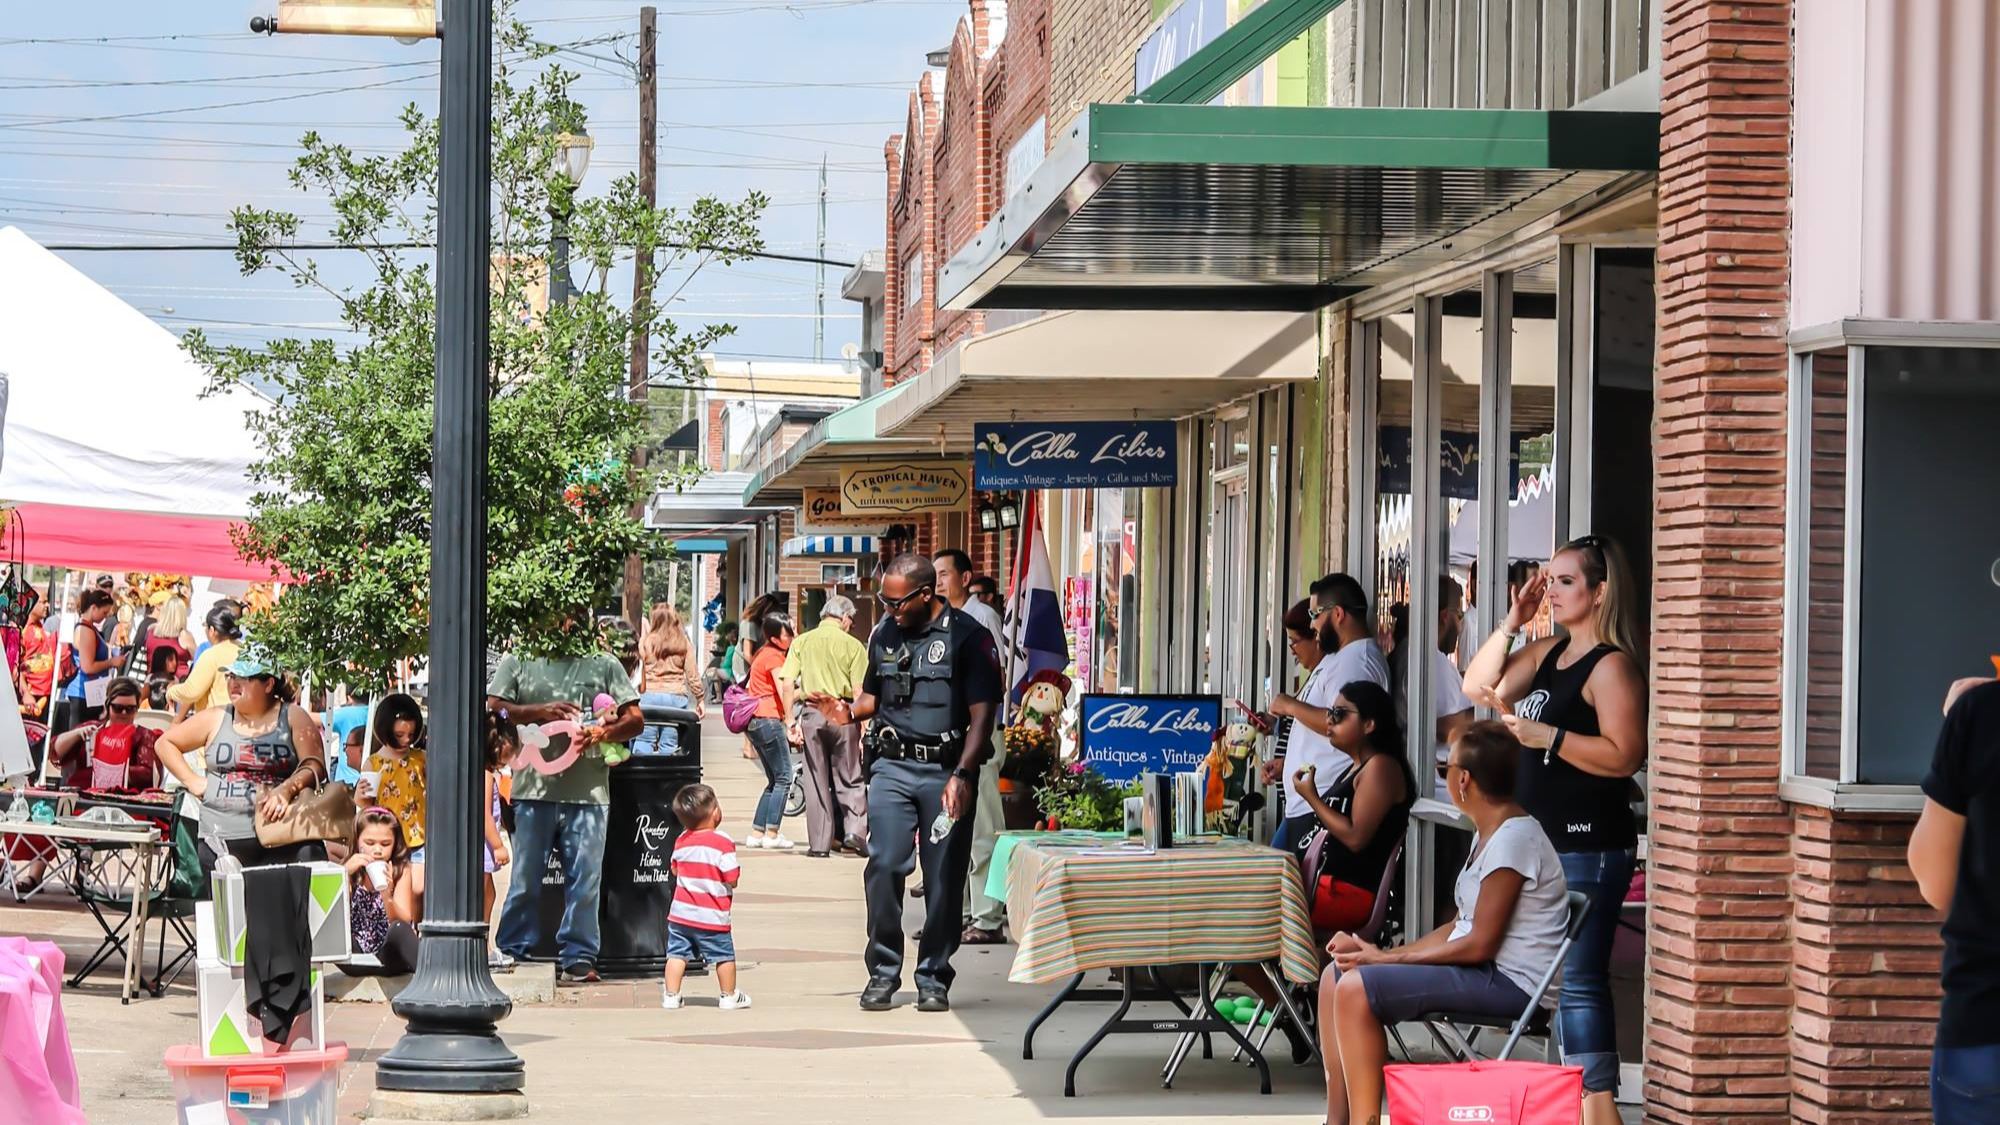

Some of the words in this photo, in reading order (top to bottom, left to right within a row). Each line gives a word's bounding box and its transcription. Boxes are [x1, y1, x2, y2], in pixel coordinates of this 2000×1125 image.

[1007, 431, 1079, 467] Calla
[1090, 431, 1166, 464] Lilies
[852, 483, 859, 492] A
[862, 472, 914, 488] TROPICAL
[920, 472, 958, 489] HAVEN
[980, 475, 1019, 487] Antiques
[1064, 473, 1098, 486] Jewelry
[1107, 472, 1130, 483] Gifts
[1132, 472, 1148, 483] and
[1151, 472, 1173, 482] More
[1087, 703, 1149, 733] Calla
[1148, 707, 1211, 736] Lilies
[1085, 745, 1147, 767] Antiques
[1161, 749, 1205, 768] Vintag
